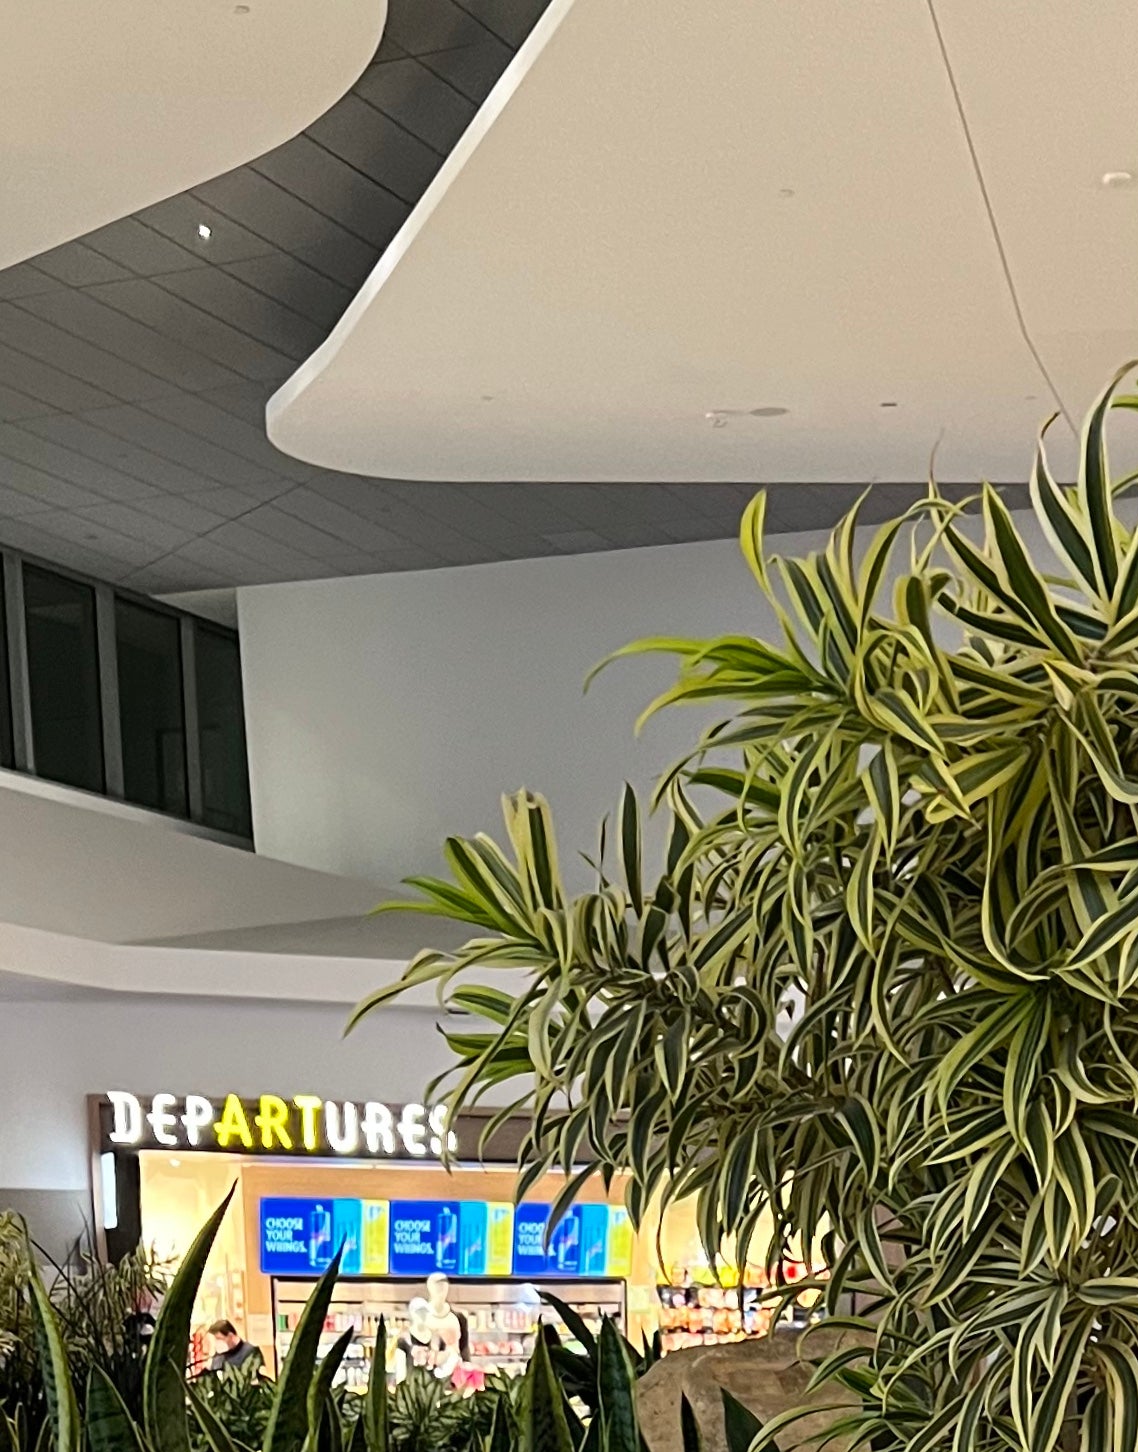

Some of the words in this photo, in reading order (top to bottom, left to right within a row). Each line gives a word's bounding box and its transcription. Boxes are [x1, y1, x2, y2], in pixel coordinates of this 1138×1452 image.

[106, 1090, 457, 1155] DEPARTURES
[265, 1218, 303, 1230] CHOOSE
[266, 1230, 293, 1241] YOUR
[395, 1232, 421, 1242] YOUR
